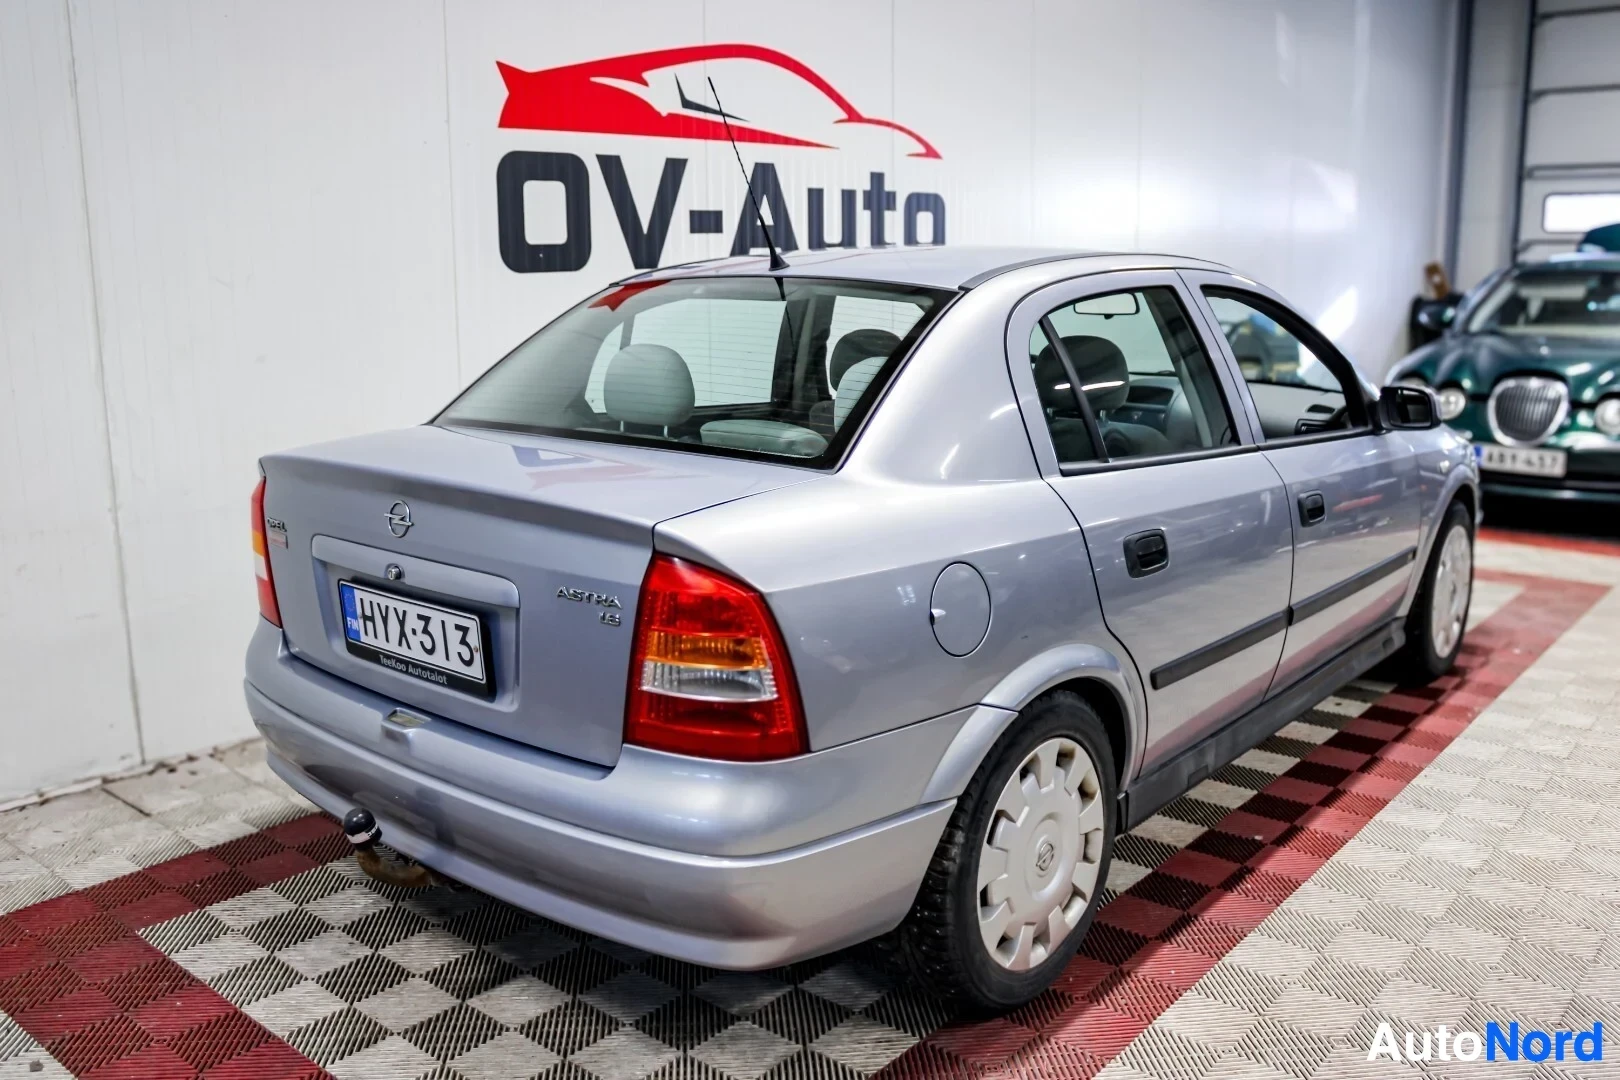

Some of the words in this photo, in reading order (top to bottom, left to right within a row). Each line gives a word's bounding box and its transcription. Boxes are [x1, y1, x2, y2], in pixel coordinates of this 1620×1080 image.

[497, 150, 946, 273] OV-Auto
[557, 586, 622, 609] ASTRA
[347, 617, 360, 631] FIN
[360, 598, 474, 667] HYX-313
[379, 655, 407, 672] TeeKoo
[408, 664, 448, 685] Autotalot
